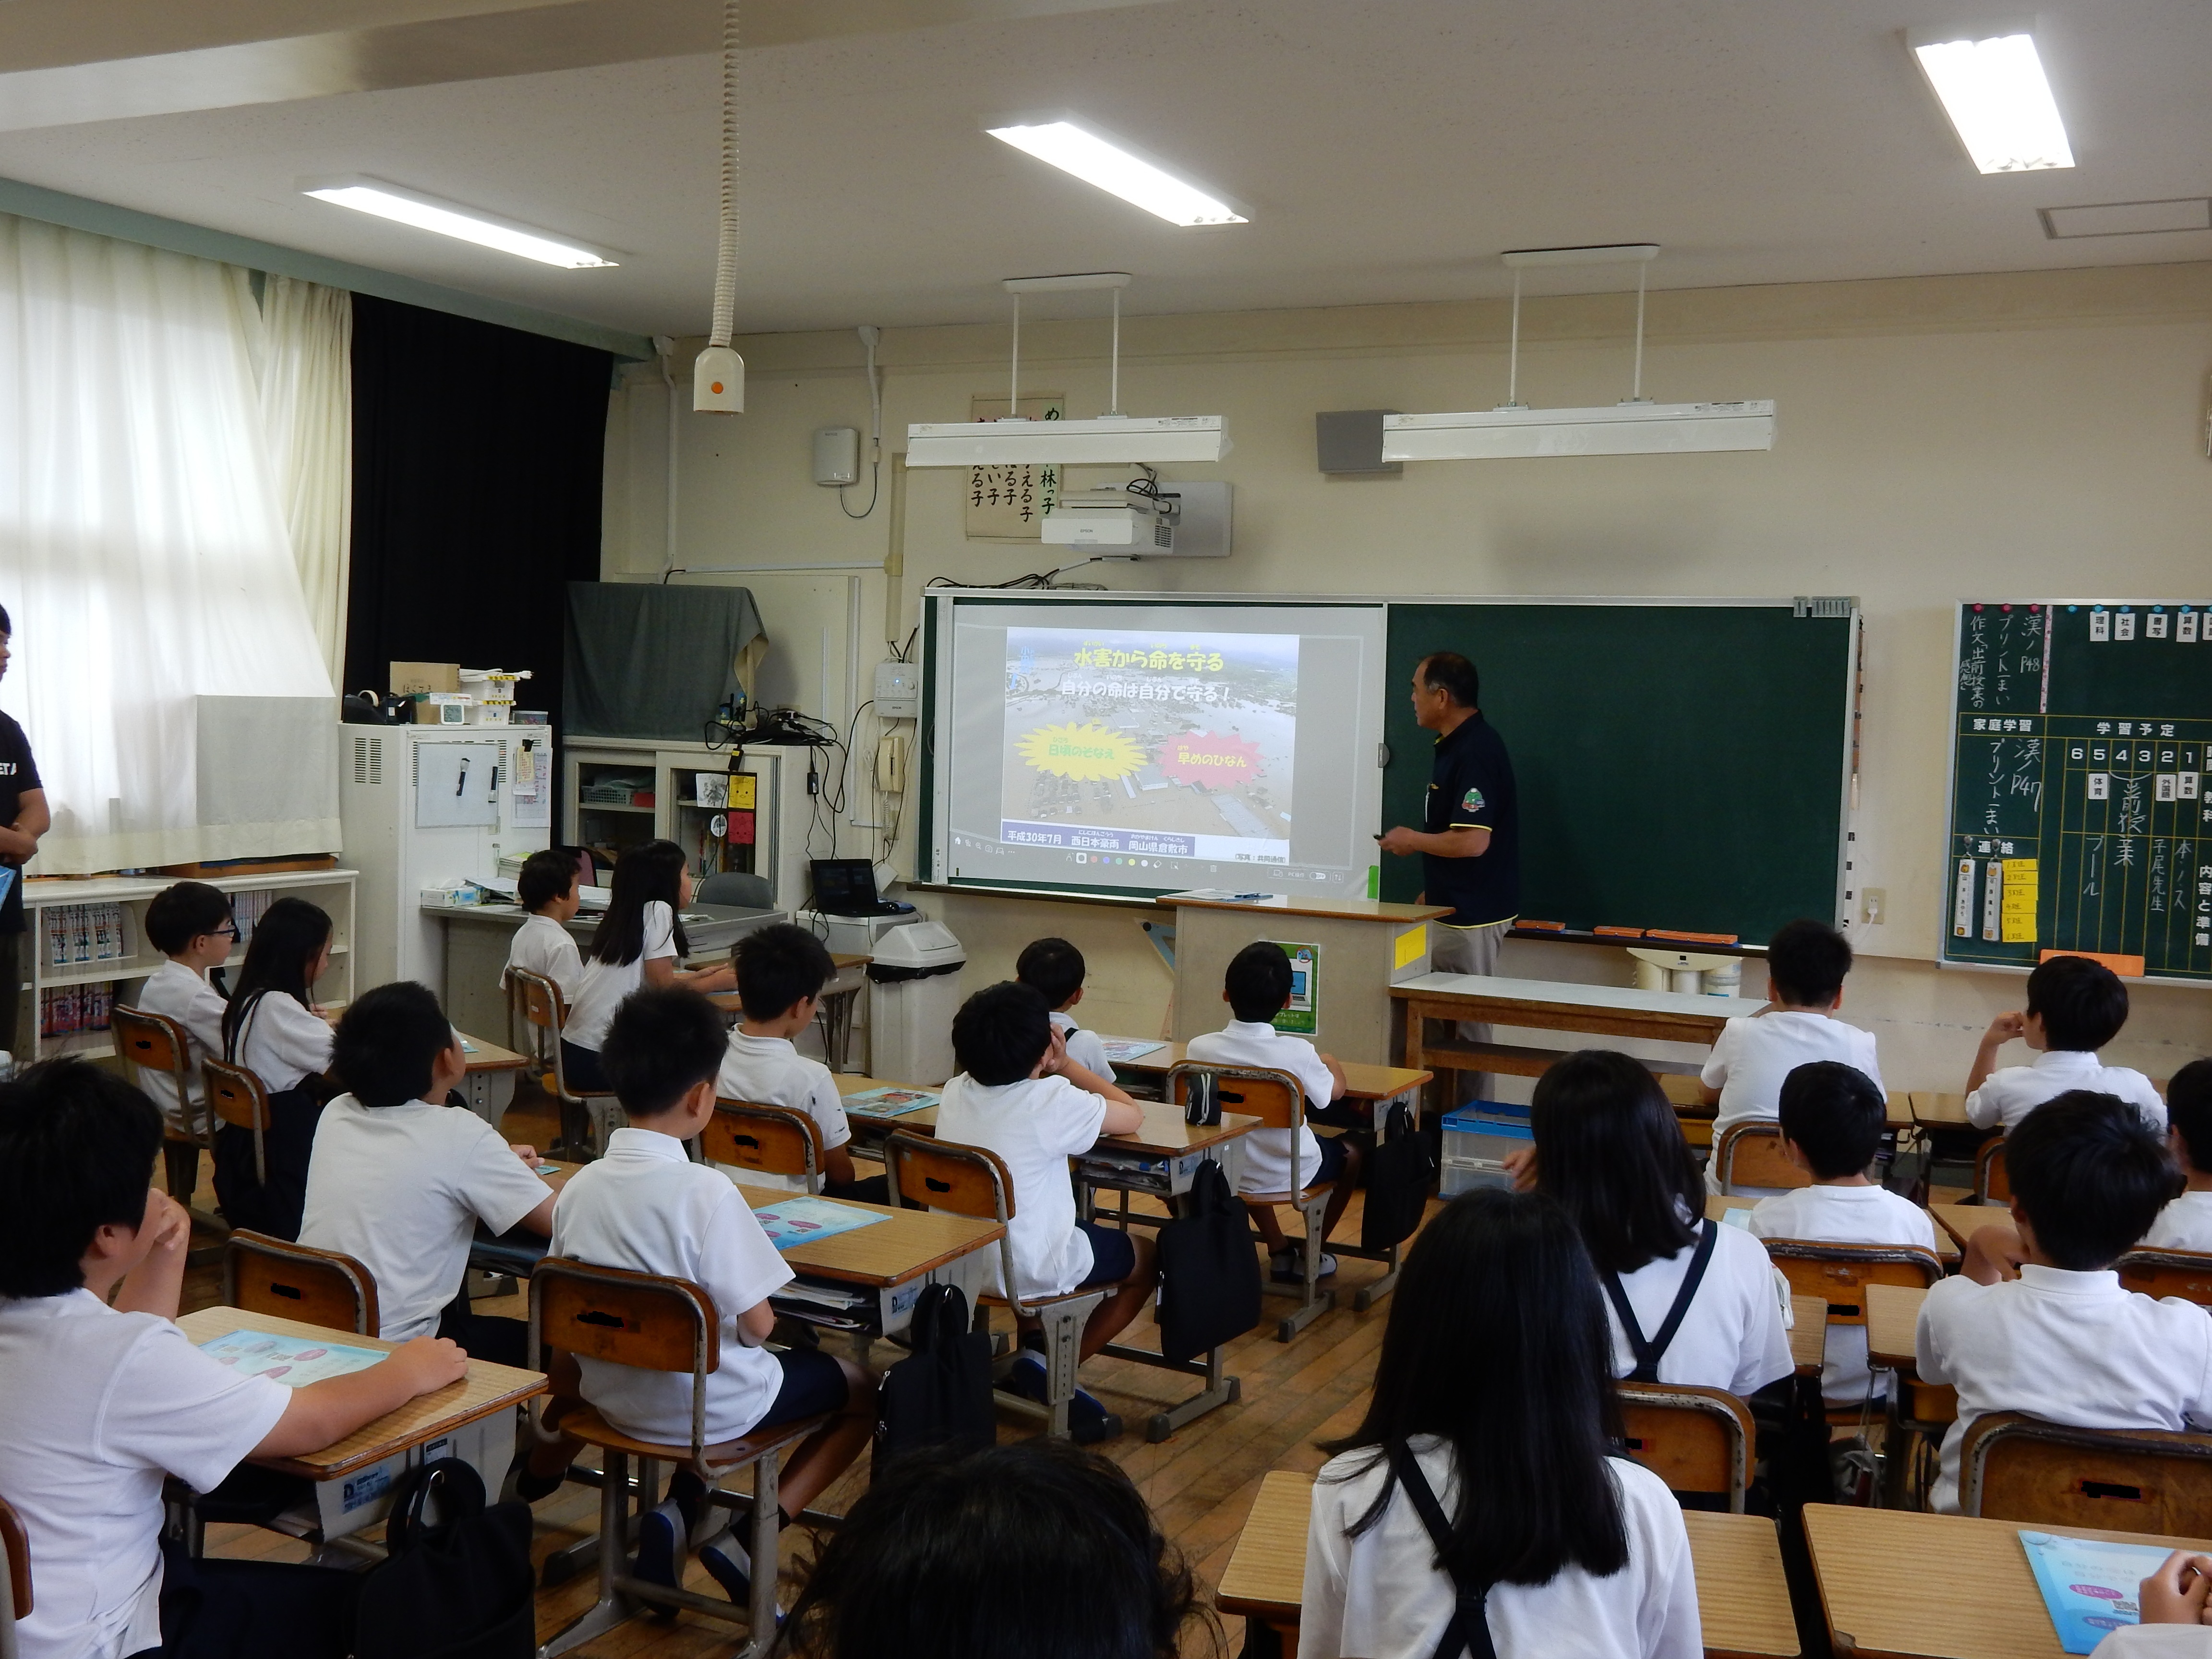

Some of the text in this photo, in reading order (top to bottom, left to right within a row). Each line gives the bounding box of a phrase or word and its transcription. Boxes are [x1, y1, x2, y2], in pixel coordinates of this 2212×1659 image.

[987, 465, 1001, 505] い子
[1003, 464, 1017, 505] る子
[1020, 464, 1033, 522] える子
[1040, 469, 1057, 514] 林っ子
[2120, 618, 2130, 636] 社会
[1074, 648, 1224, 672] 水害から命を守る
[2020, 656, 2041, 673] P48
[1973, 719, 2032, 732] 家庭学習
[2096, 722, 2175, 737] 学習予定
[1048, 744, 1115, 759] 日頃のそなえ
[1178, 752, 1247, 768] 早めのひなん
[2071, 748, 2192, 763] 6 5 4 3 2 1
[2094, 778, 2103, 796] 体育
[1008, 830, 1062, 845] 平成30年7月
[1071, 836, 1119, 849] 西日本豪雨
[1129, 841, 1188, 855] 岡山県倉敷市
[1978, 841, 2014, 854] 連絡
[2083, 835, 2104, 896] プール
[2195, 865, 2212, 946] 内容と準備
